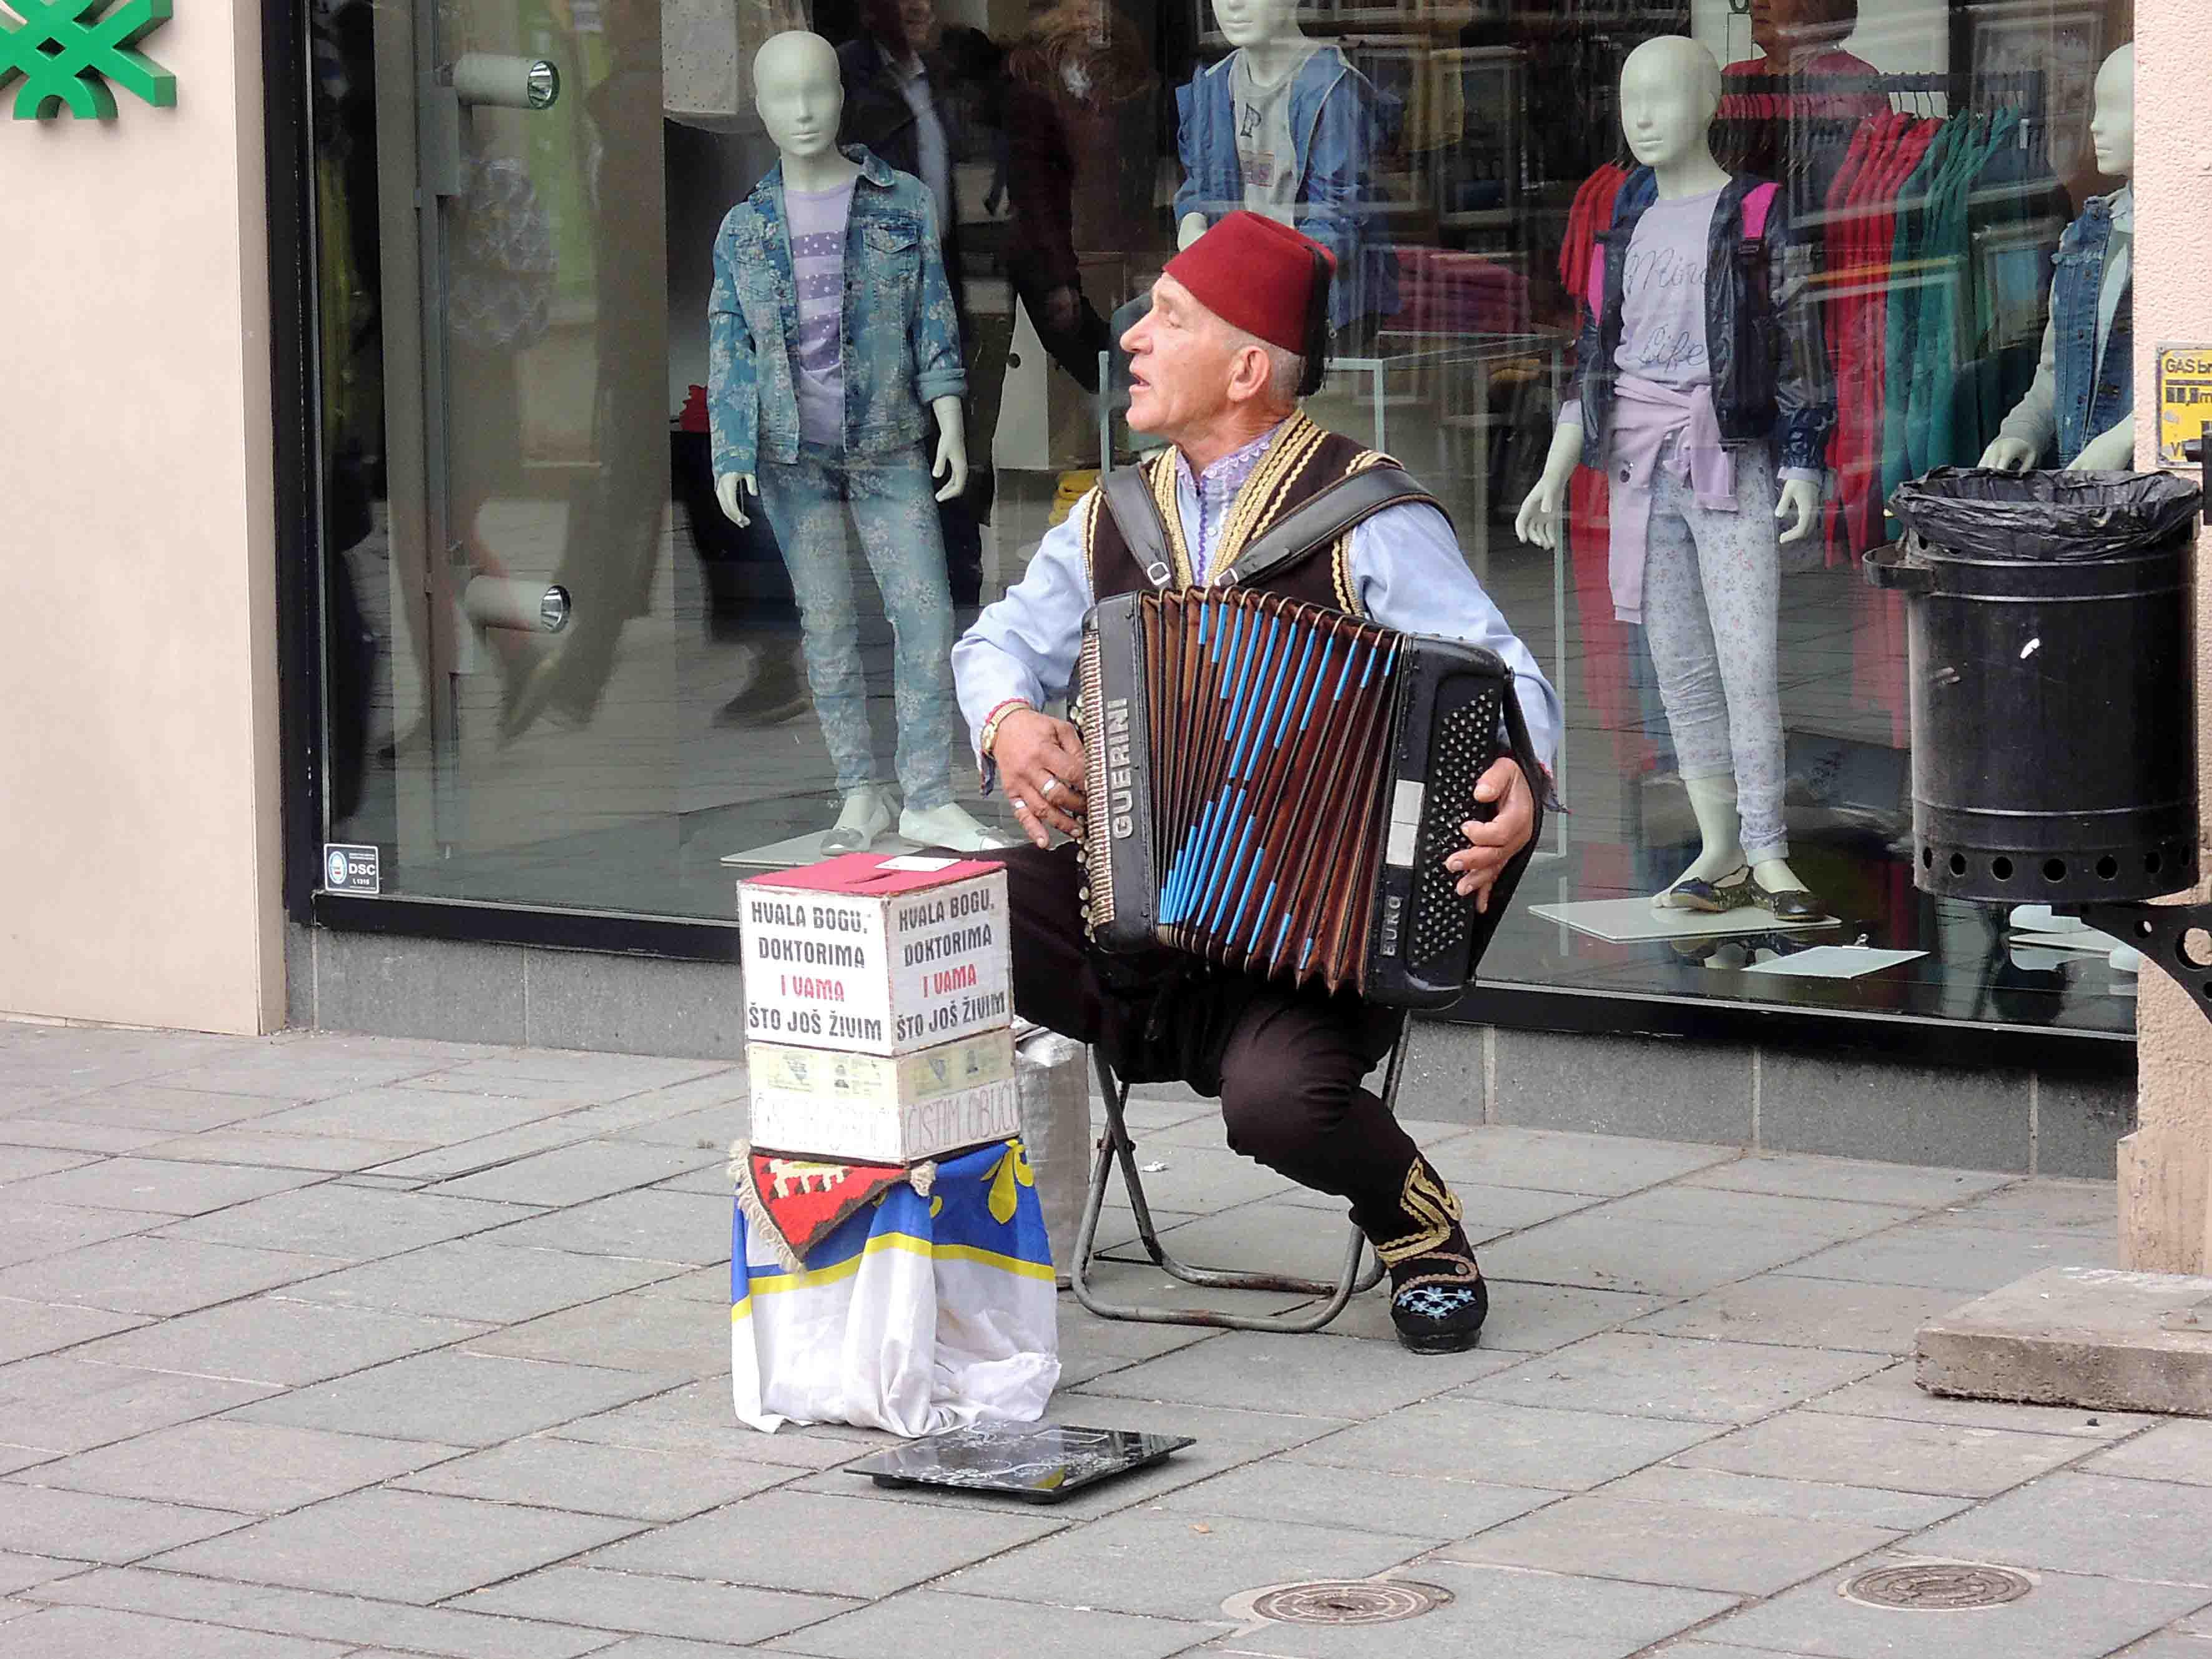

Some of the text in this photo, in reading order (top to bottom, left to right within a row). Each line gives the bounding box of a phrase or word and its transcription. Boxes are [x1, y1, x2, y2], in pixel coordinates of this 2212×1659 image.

[2166, 358, 2195, 373] GAS
[1108, 697, 1134, 839] GUERINI
[349, 863, 376, 875] DSC
[759, 937, 864, 968] DOKTORIMA
[905, 923, 992, 967] DOKTORIMA
[781, 974, 786, 997] I
[923, 975, 928, 998] I
[749, 1002, 780, 1030] ŠTO
[787, 1008, 822, 1035] JOŠ
[897, 1013, 924, 1041] ŠTO
[929, 1000, 958, 1033] JOŠ
